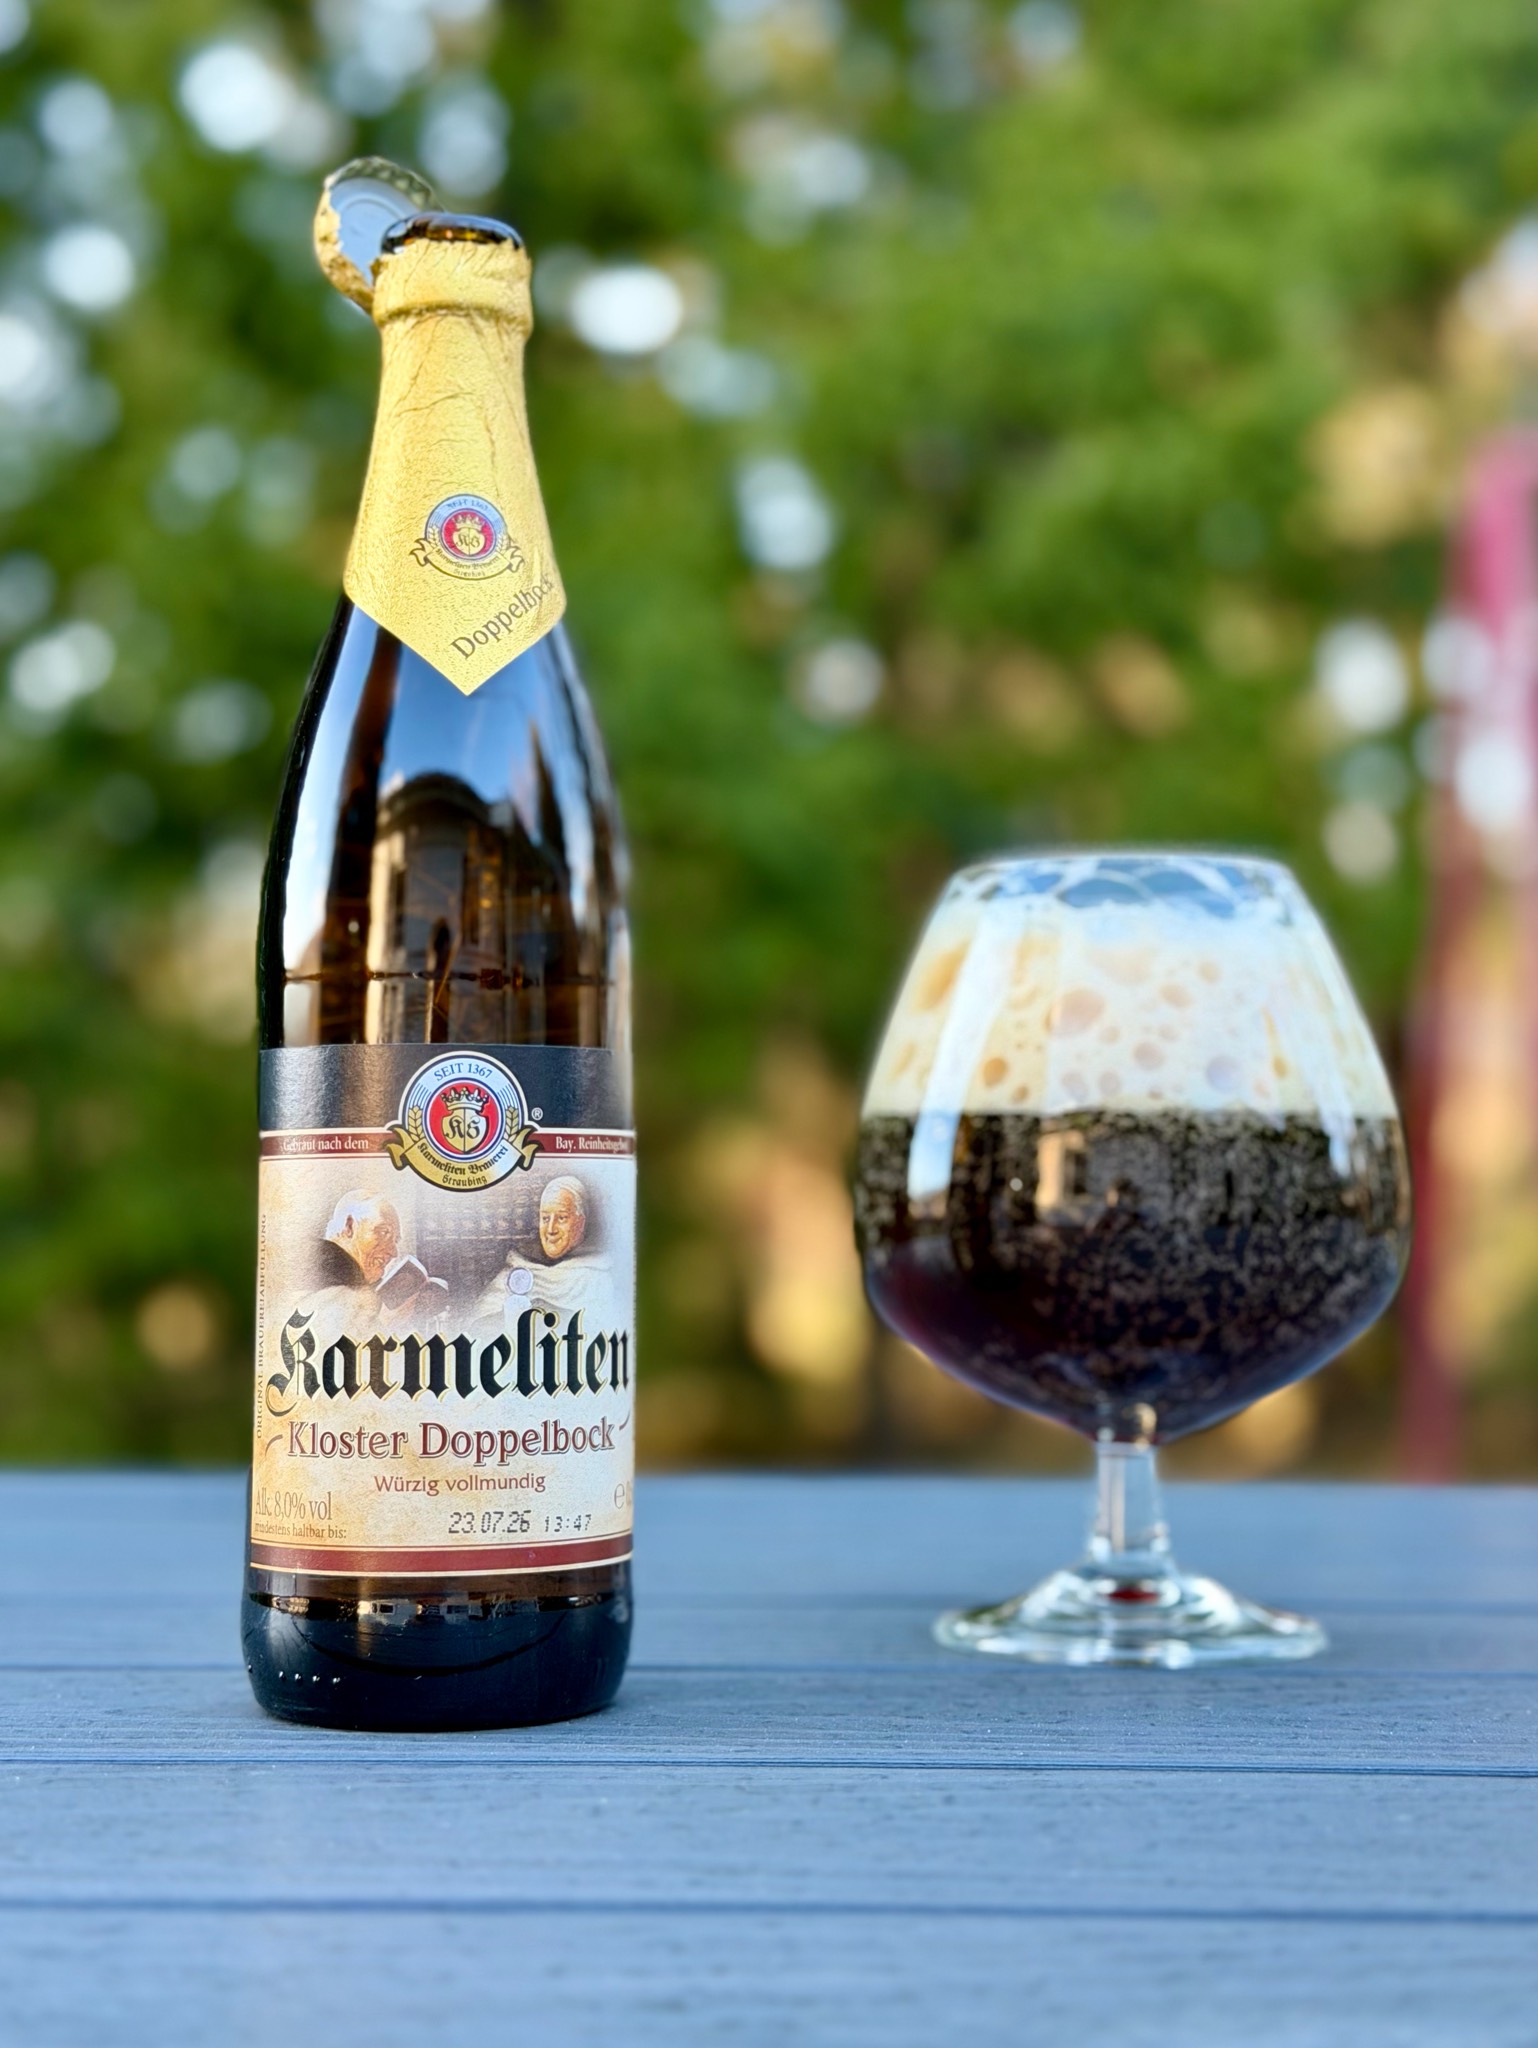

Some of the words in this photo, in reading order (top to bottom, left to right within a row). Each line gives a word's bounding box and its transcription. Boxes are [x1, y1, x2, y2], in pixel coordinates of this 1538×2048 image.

[433, 1062, 463, 1082] SEIT
[467, 1063, 493, 1079] 1367
[283, 1138, 316, 1151] Gebraut
[317, 1136, 342, 1150] nach
[344, 1136, 369, 1149] dem
[555, 1136, 577, 1152] Bay.
[441, 1175, 488, 1187] Straubing
[266, 1308, 630, 1417] Karmeliten
[257, 1371, 265, 1439] ORIGINAL
[287, 1420, 408, 1459] Kloster
[419, 1416, 616, 1467] Doppelbock
[374, 1475, 440, 1497] Würzig
[446, 1472, 546, 1493] vollmundig
[274, 1490, 306, 1520] 8,0%
[308, 1491, 332, 1520] vol
[255, 1521, 291, 1536] mindestens
[292, 1523, 327, 1538] haltbar
[328, 1525, 347, 1539] bis:
[448, 1509, 532, 1534] 23.07.26
[544, 1514, 592, 1532] 13:47
